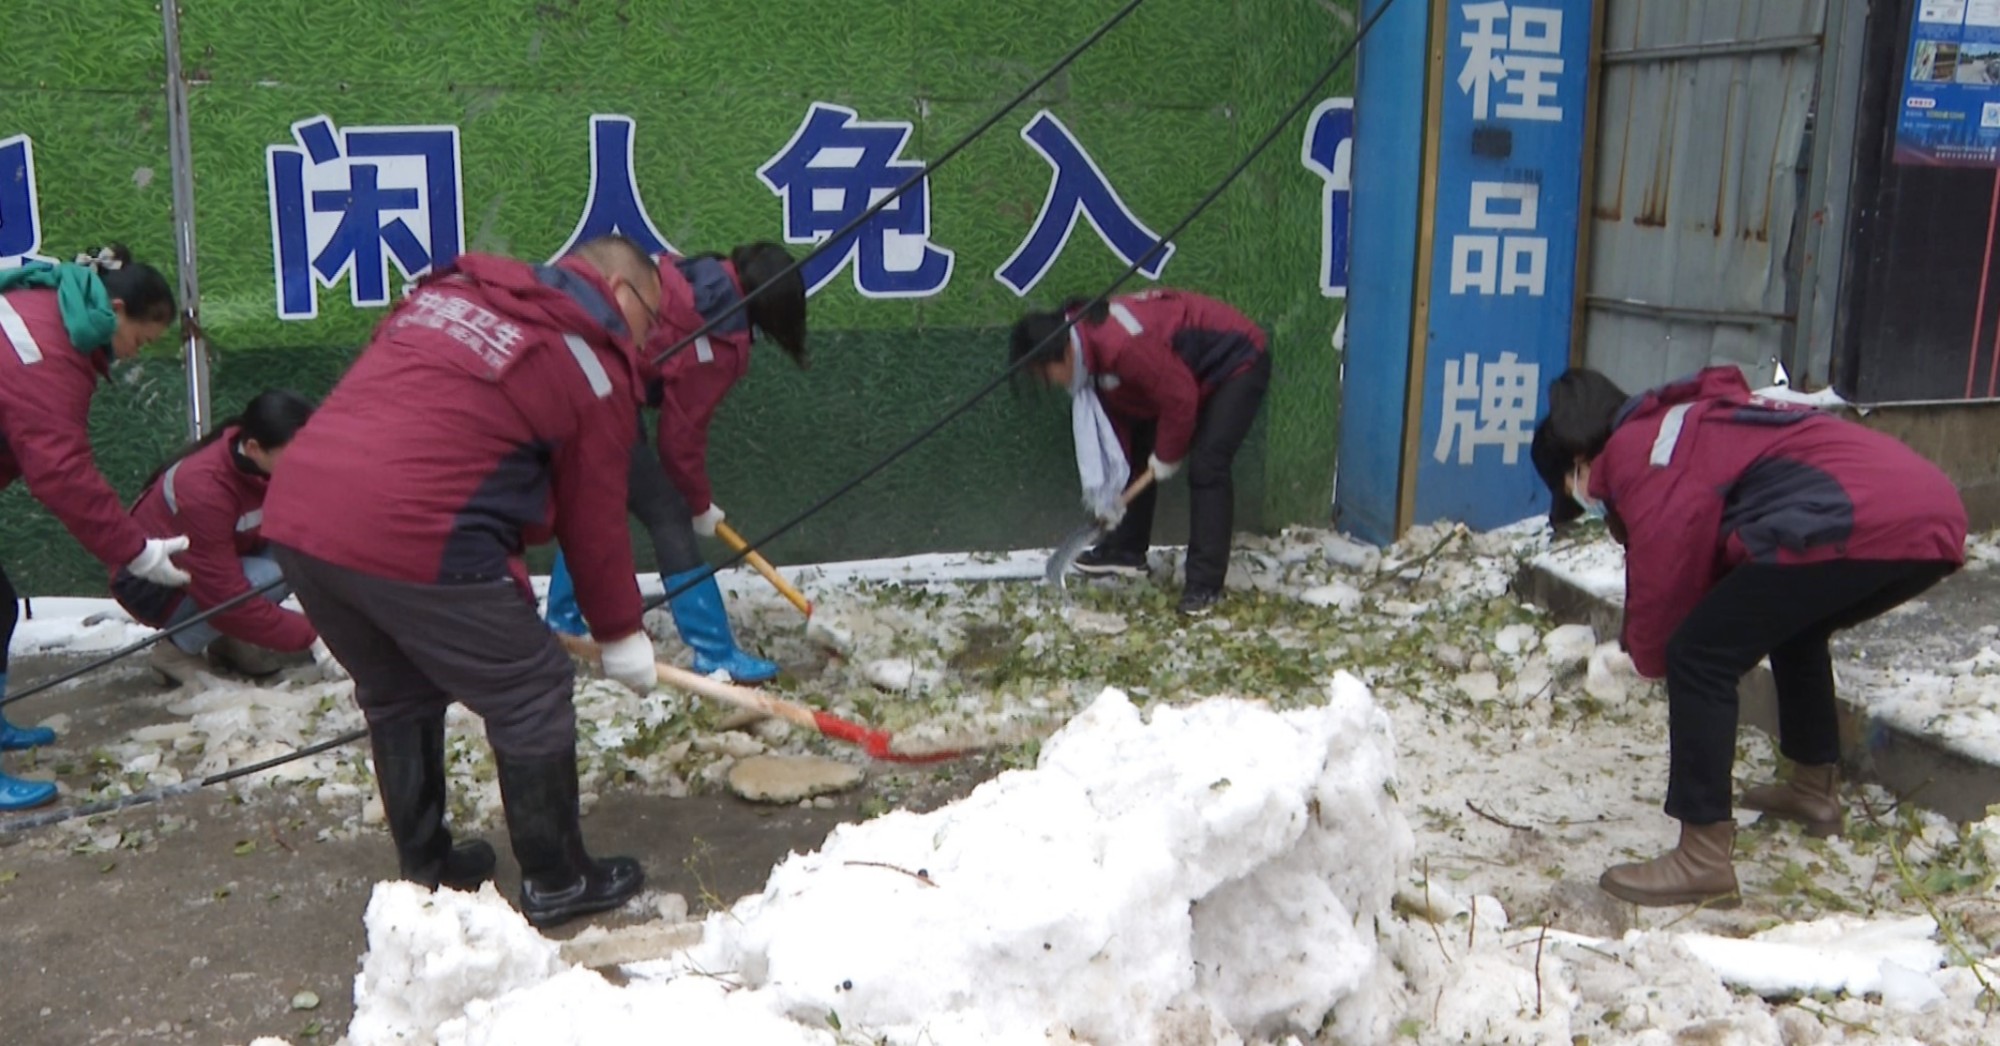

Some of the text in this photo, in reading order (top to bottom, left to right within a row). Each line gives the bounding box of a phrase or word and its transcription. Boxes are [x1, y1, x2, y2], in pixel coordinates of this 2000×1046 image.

[415, 290, 525, 348] 中国卫生
[1434, 1, 1565, 465] 程品牌
